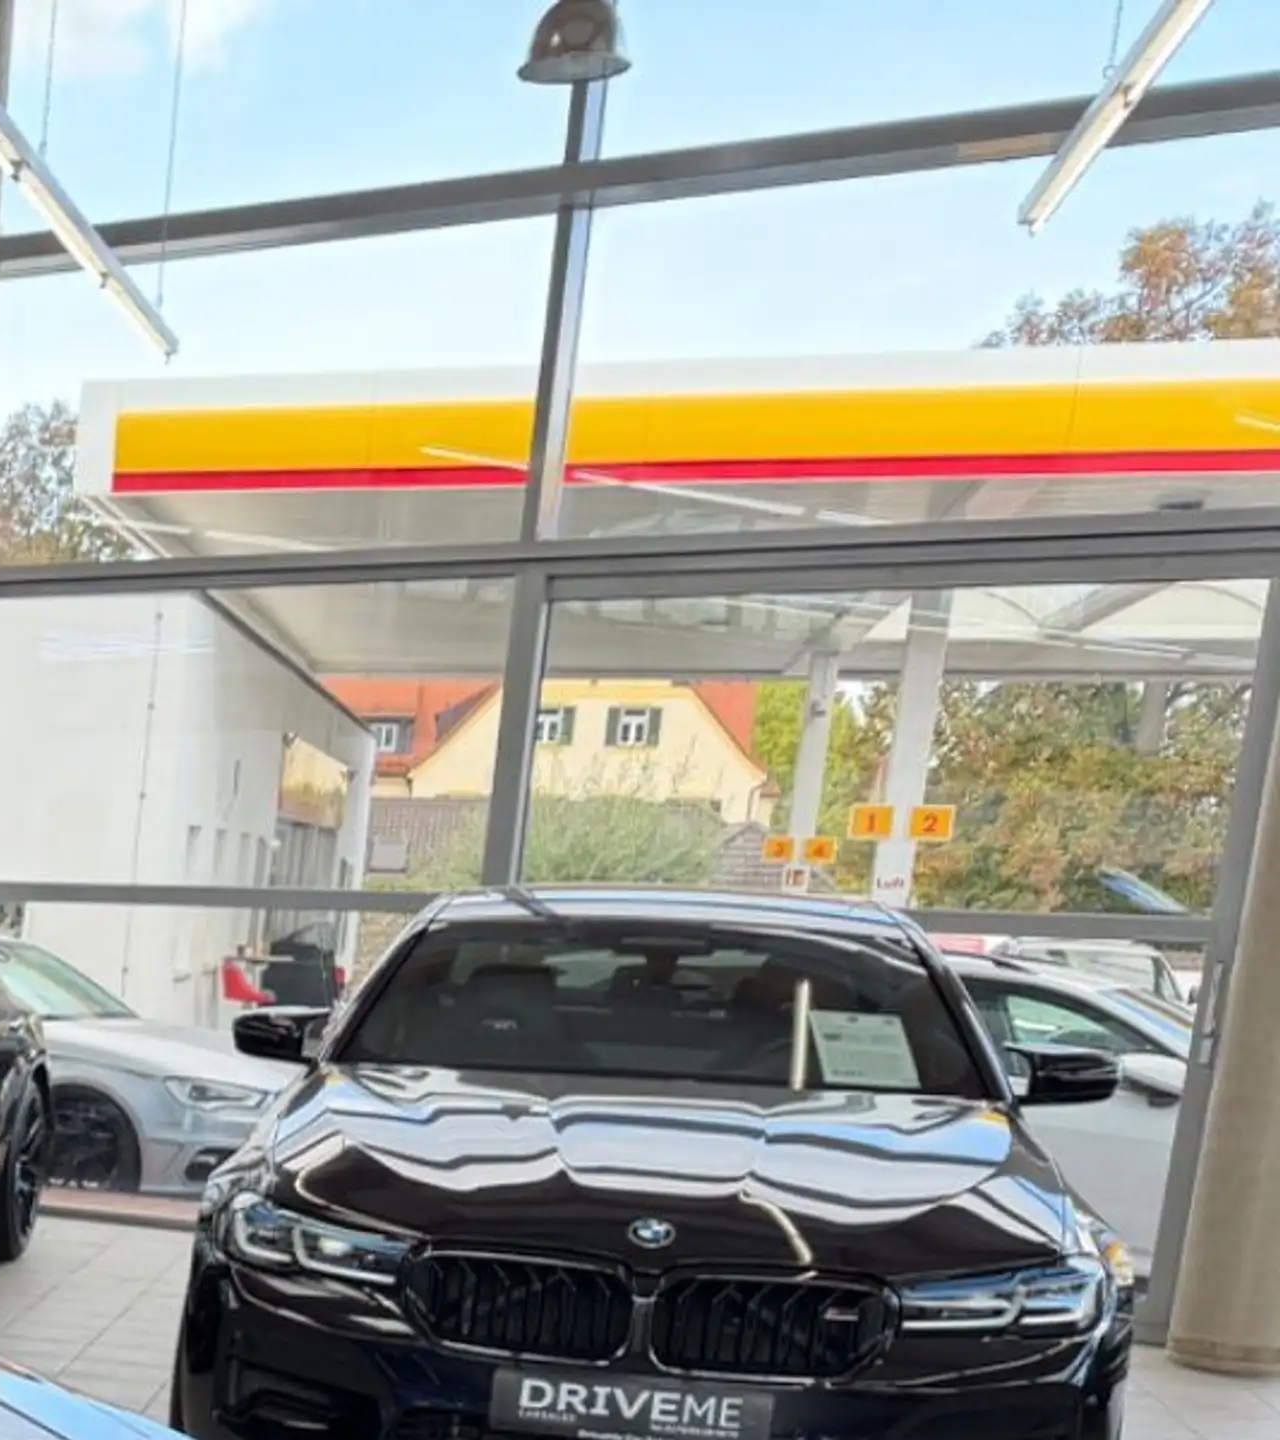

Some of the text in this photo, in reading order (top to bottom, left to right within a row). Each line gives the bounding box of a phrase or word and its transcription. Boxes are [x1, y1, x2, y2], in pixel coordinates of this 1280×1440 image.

[867, 813, 876, 832] 1
[922, 812, 938, 833] 2
[518, 1378, 743, 1429] DRIVEME
